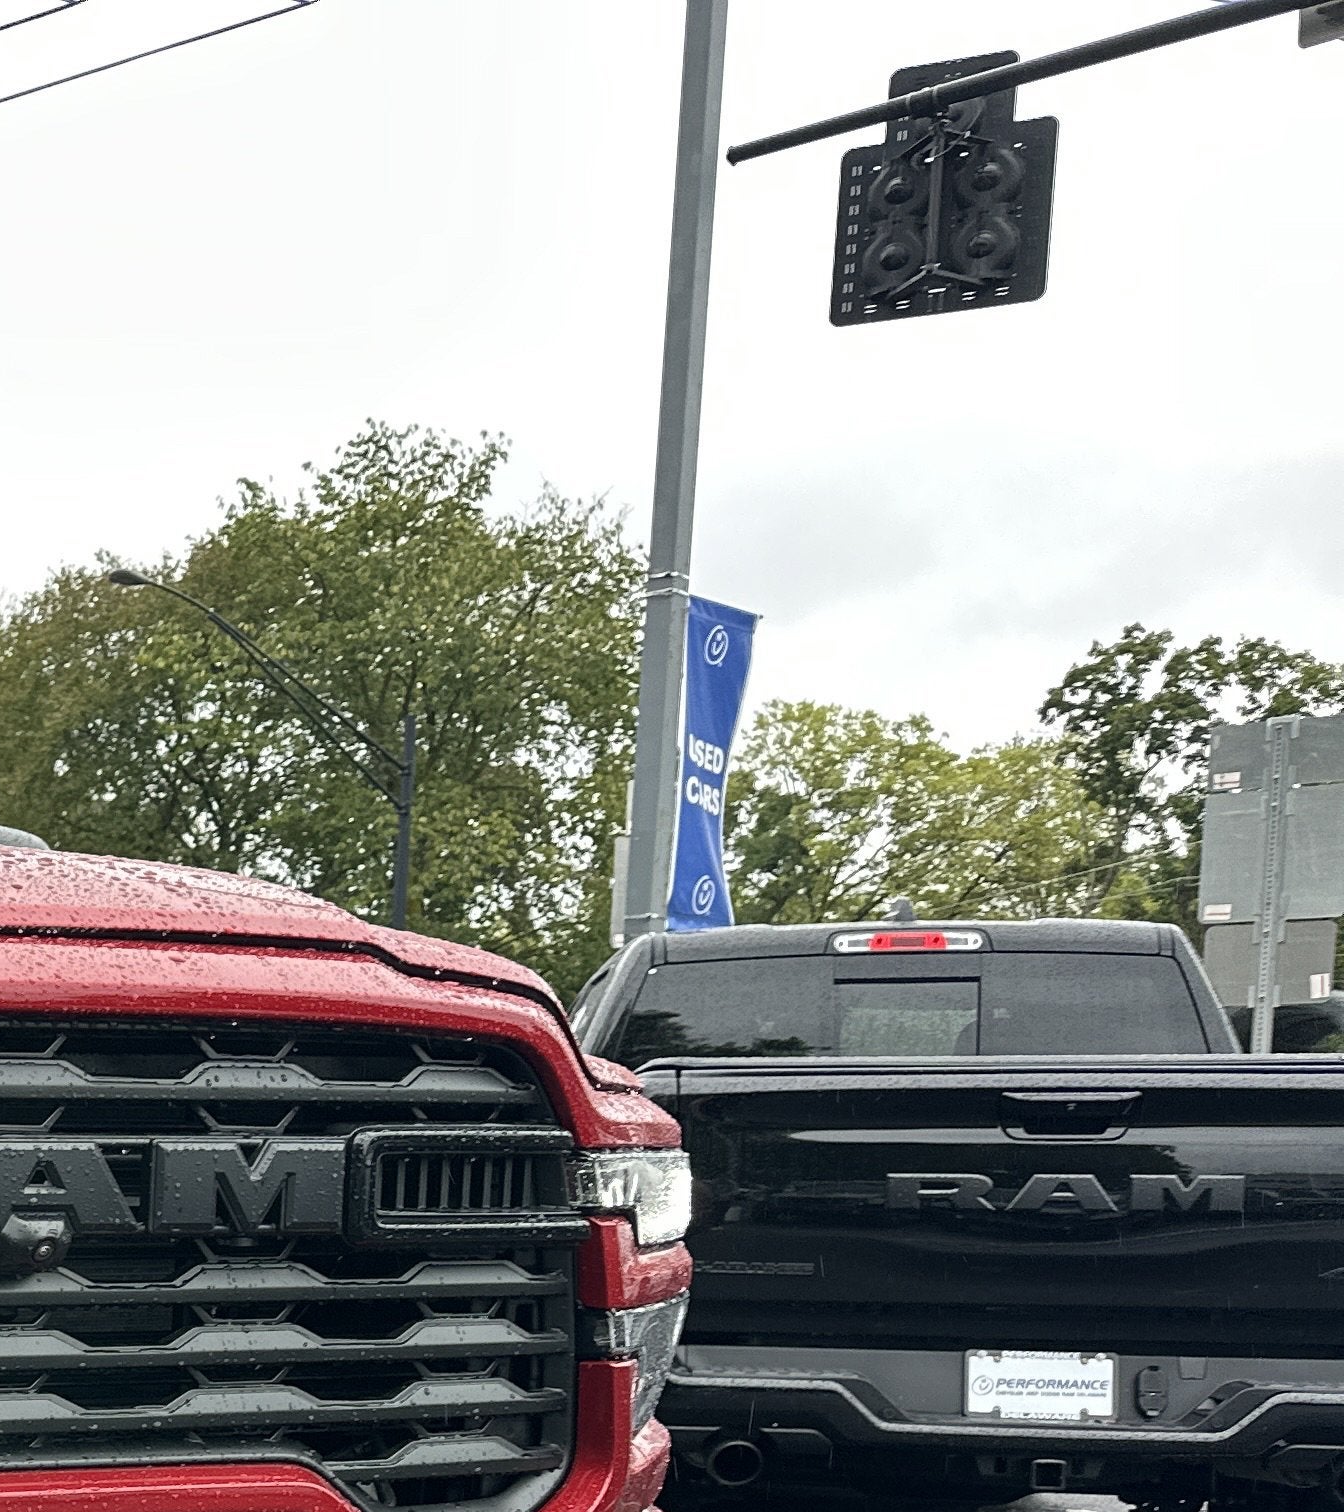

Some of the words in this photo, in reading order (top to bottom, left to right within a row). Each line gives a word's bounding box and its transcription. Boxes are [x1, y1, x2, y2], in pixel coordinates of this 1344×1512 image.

[688, 733, 724, 775] USED
[886, 1172, 1246, 1212] RAM
[995, 1378, 1110, 1391] PERFORMANCE
